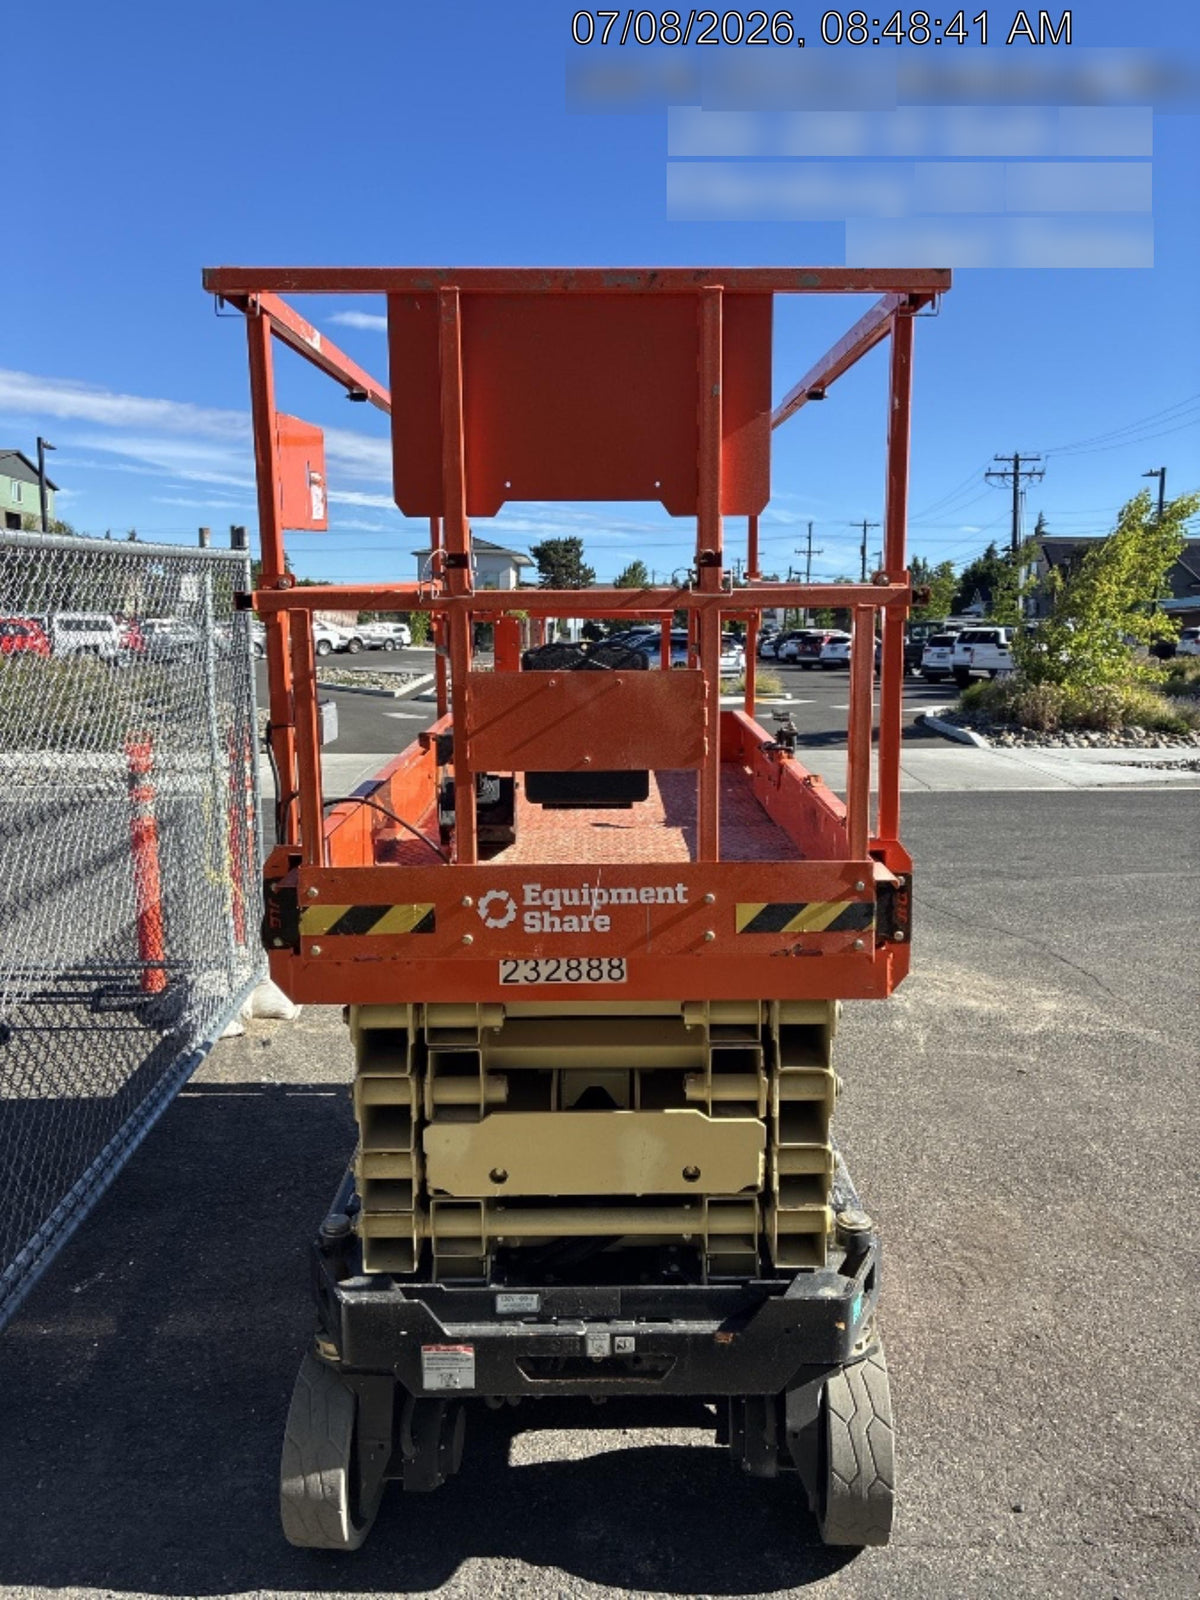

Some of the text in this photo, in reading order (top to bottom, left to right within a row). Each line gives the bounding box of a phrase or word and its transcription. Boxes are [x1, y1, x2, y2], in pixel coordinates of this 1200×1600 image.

[523, 882, 689, 909] Equipment
[523, 910, 611, 933] Share
[502, 958, 626, 984] 232888
